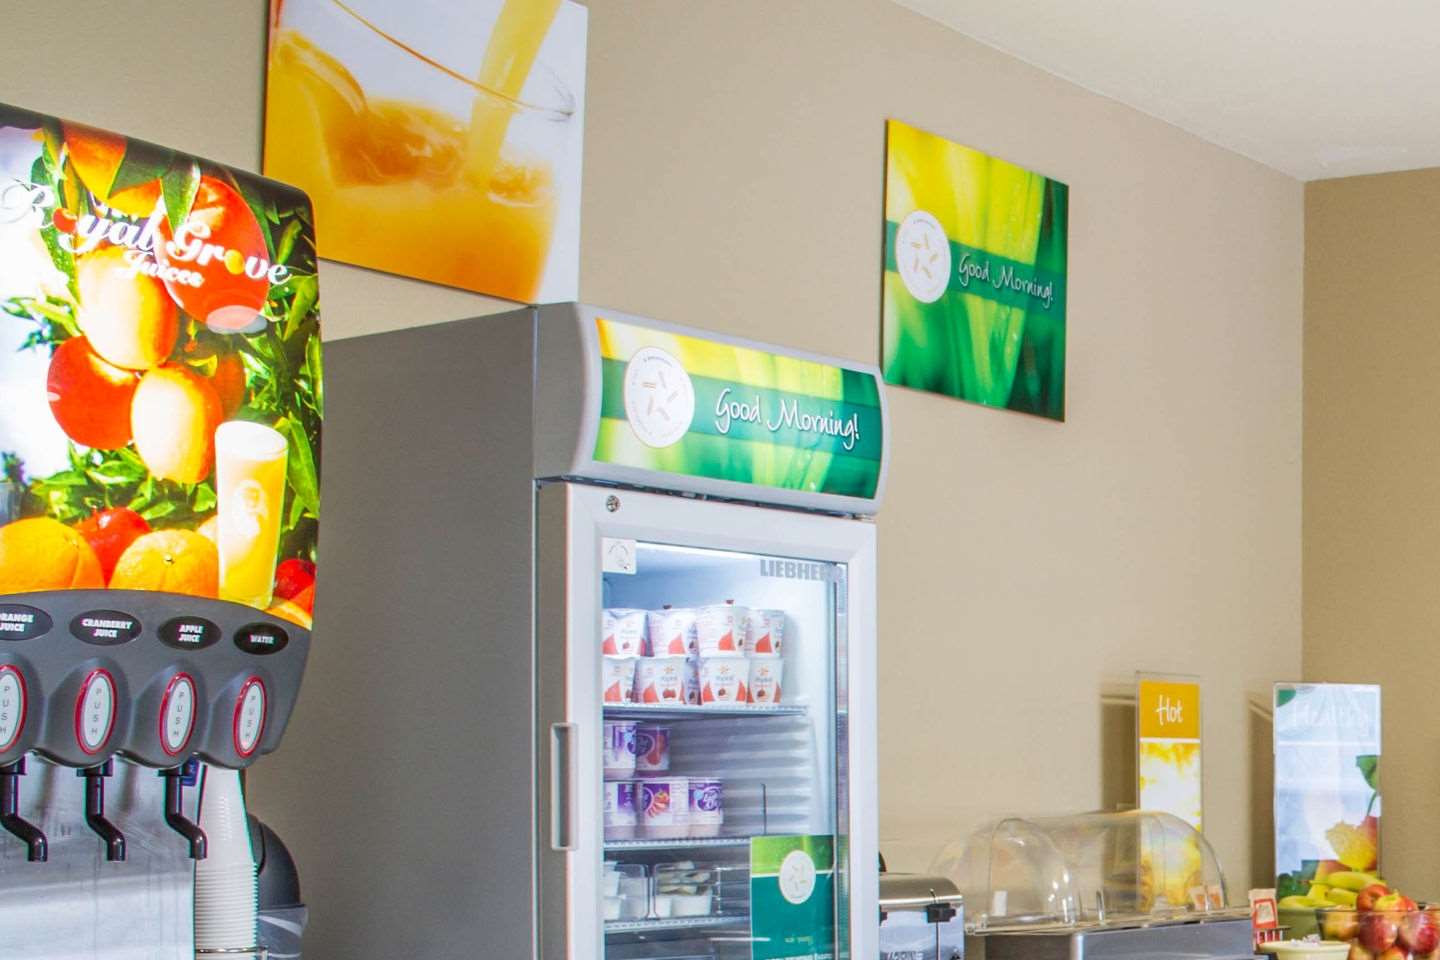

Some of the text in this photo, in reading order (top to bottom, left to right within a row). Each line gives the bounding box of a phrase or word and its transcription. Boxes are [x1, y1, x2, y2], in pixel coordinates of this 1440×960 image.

[958, 252, 1054, 309] Good Morning!
[714, 387, 860, 450] Good Morning!
[81, 618, 133, 630] CRANBERRY
[178, 624, 204, 634] APPLE
[93, 628, 118, 638] JUICE
[178, 633, 201, 643] JUICE
[249, 634, 275, 645] WATER
[1155, 694, 1183, 727] Hot
